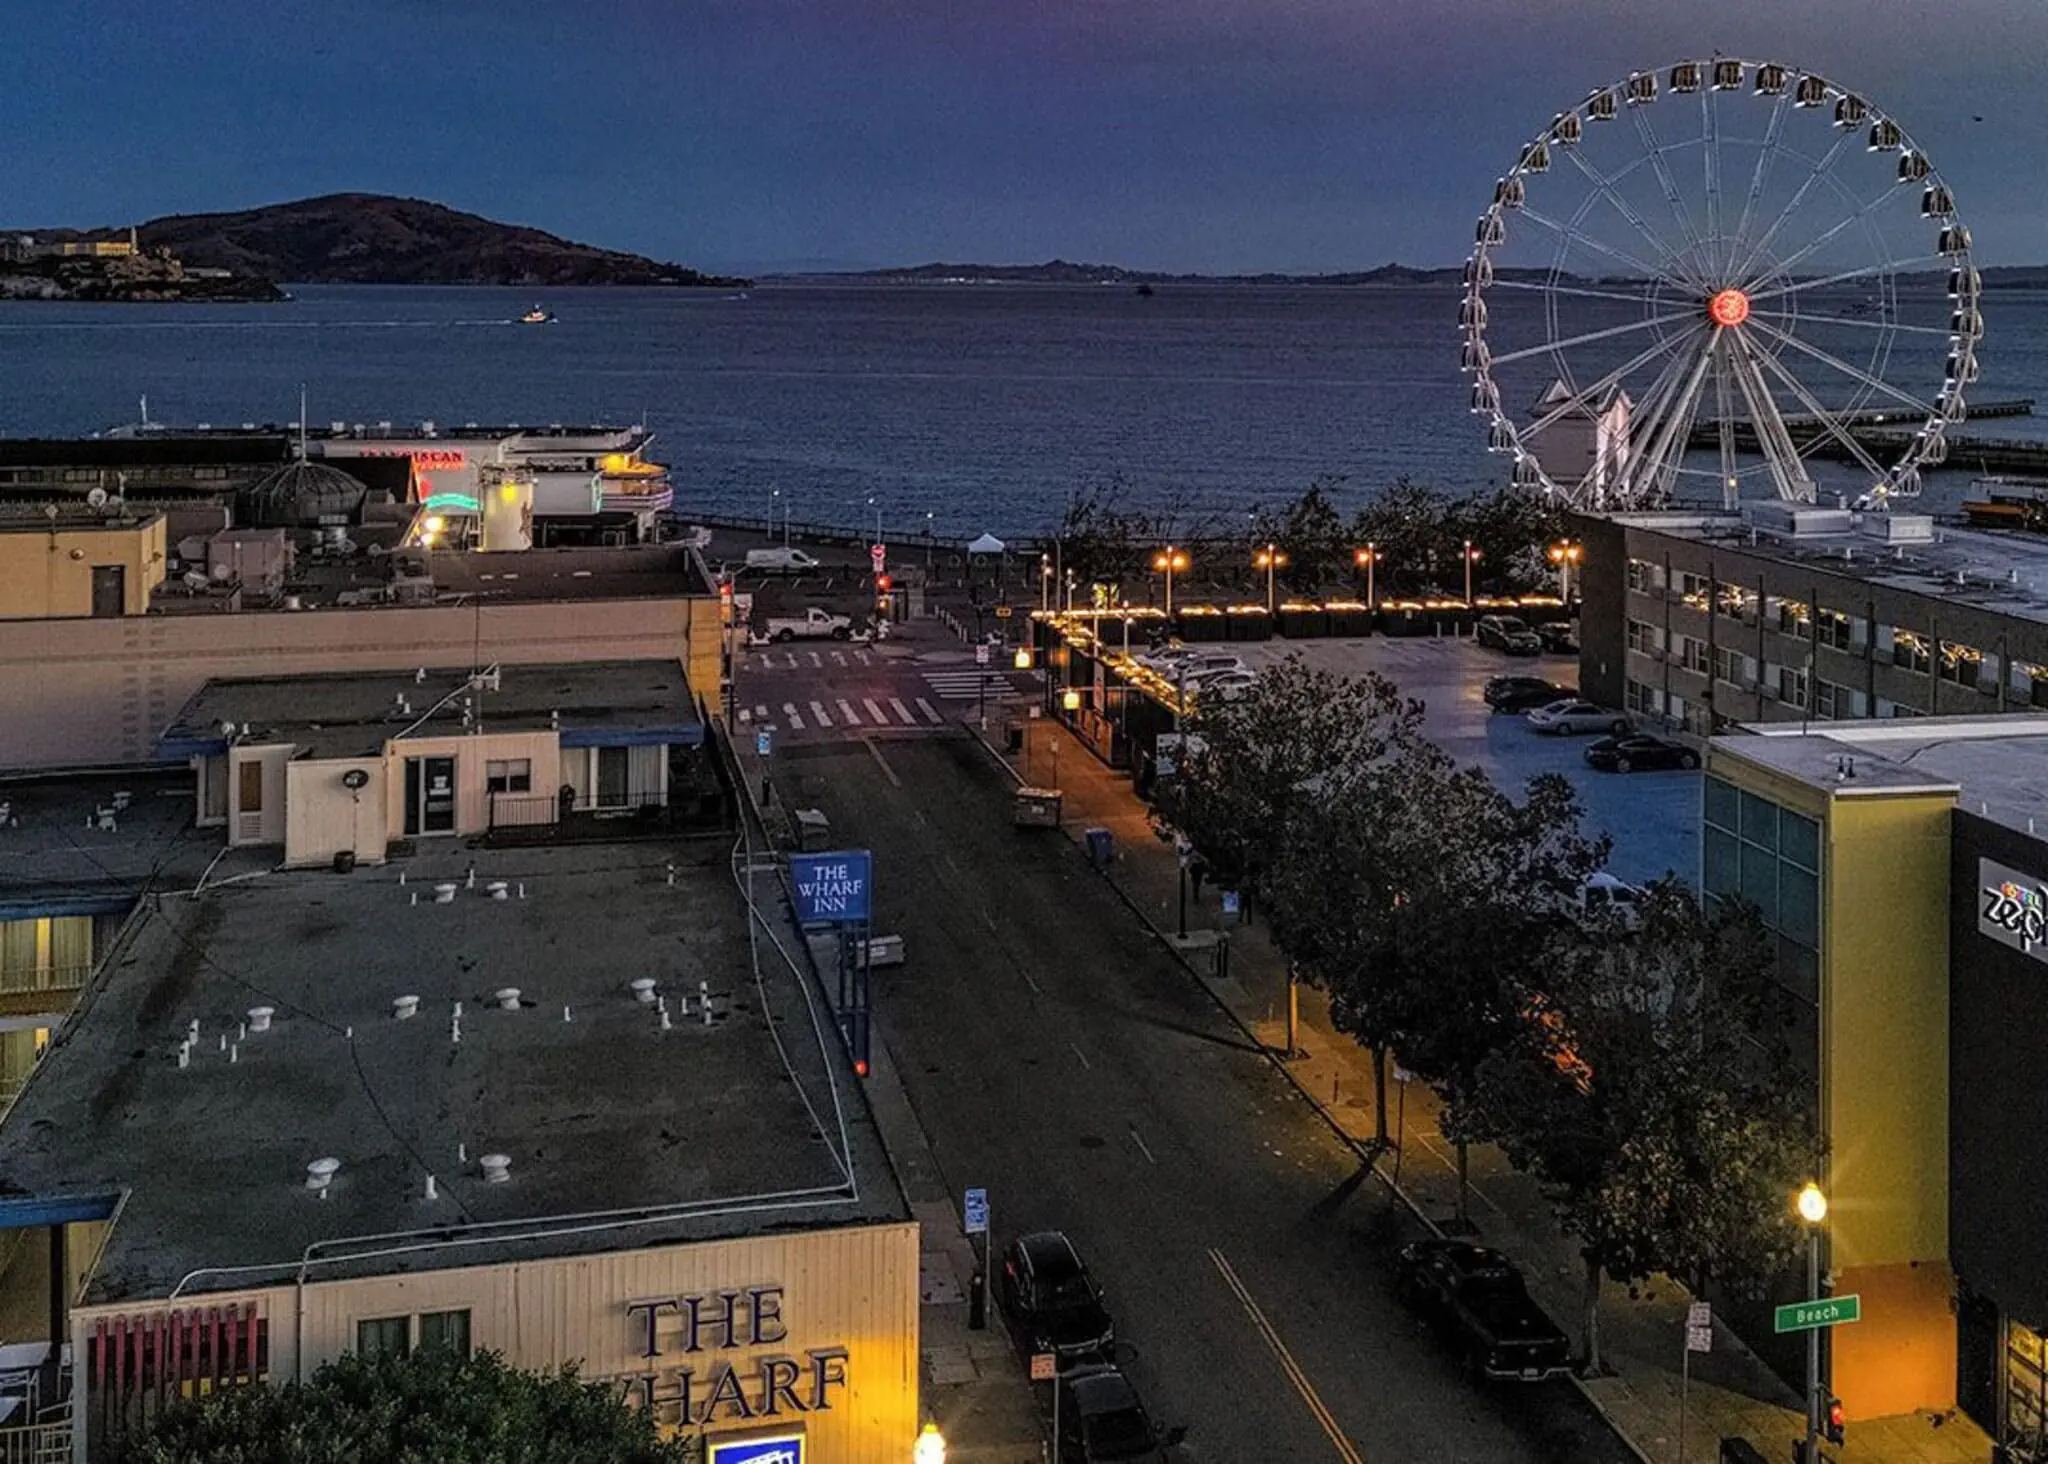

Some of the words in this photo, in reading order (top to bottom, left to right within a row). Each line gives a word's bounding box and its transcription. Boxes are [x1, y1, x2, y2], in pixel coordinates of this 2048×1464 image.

[813, 864, 847, 880] THE
[798, 880, 862, 896] WHARF
[814, 897, 846, 912] INN
[627, 1286, 788, 1358] THE
[1797, 1305, 1839, 1323] Beach
[616, 1350, 848, 1426] HARF
